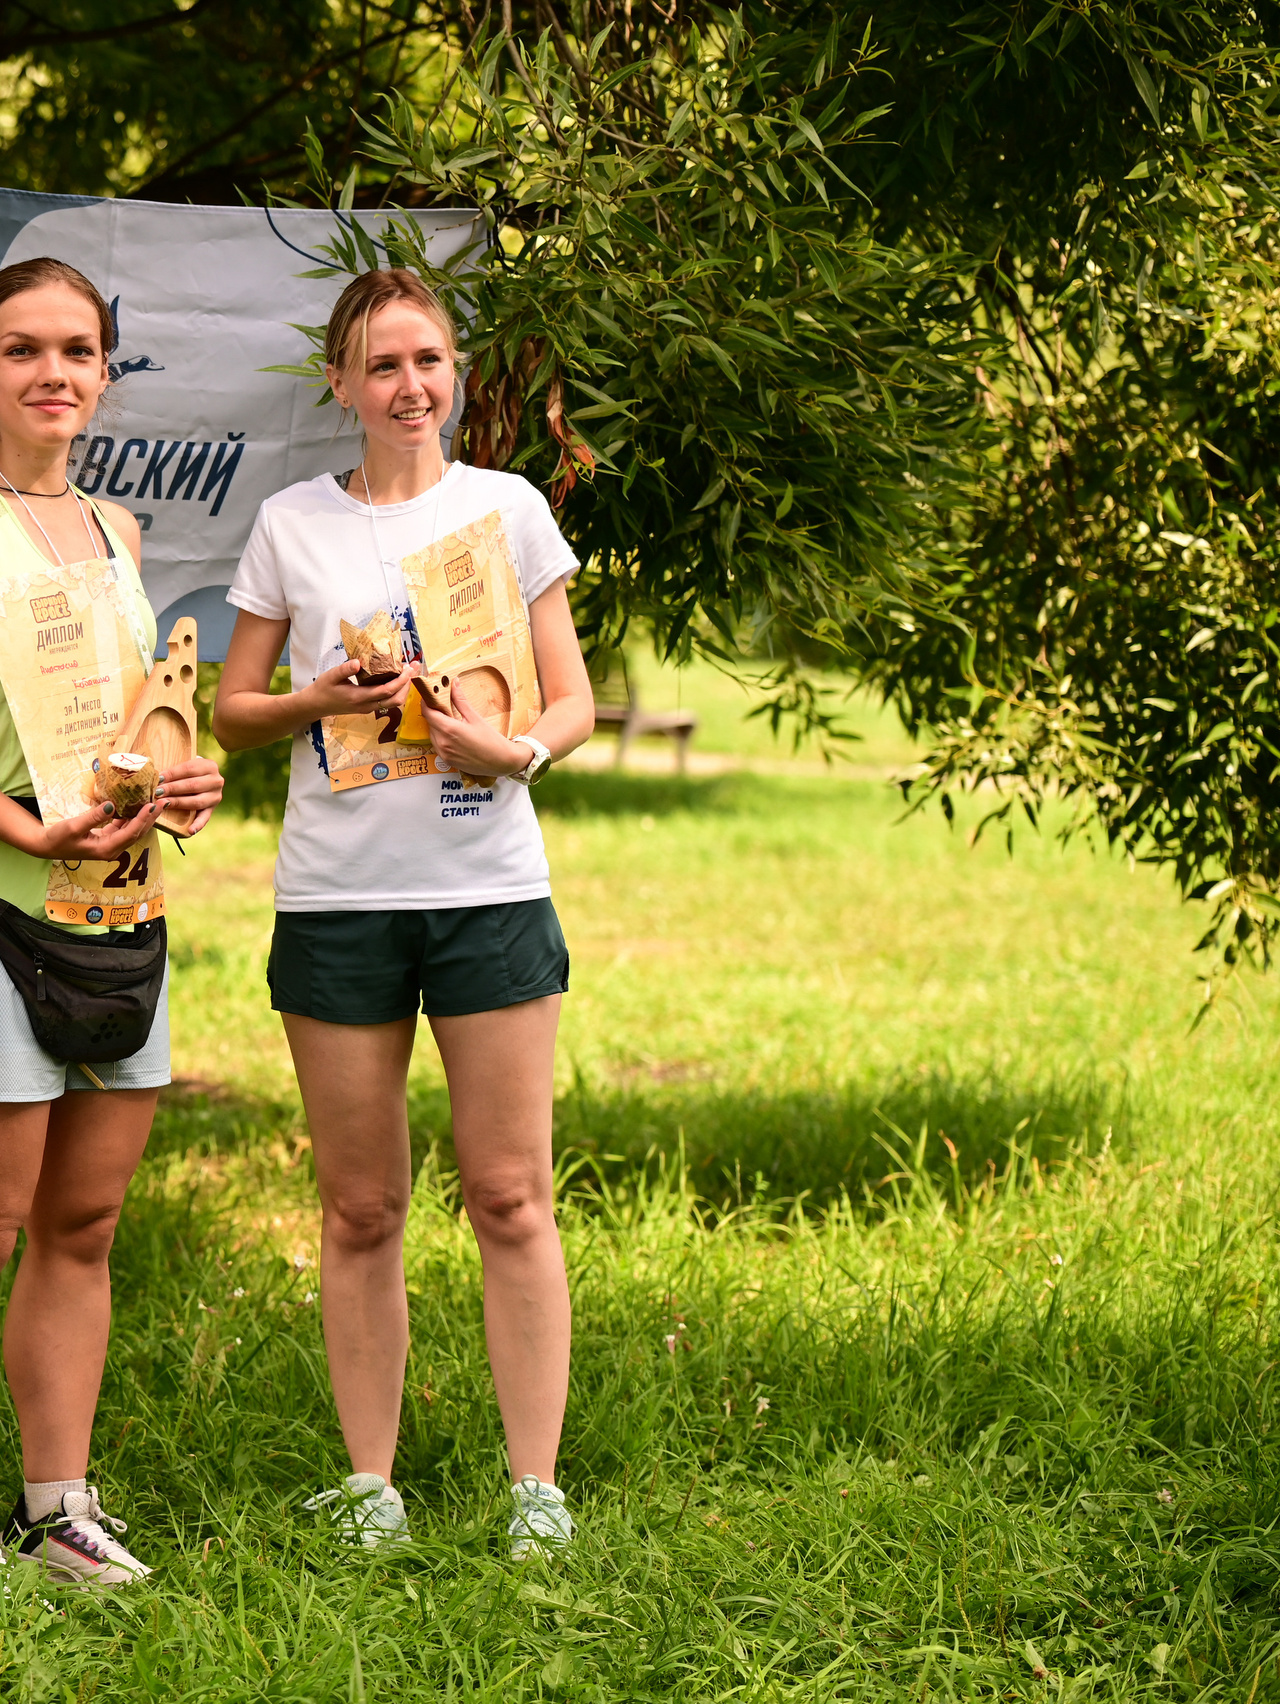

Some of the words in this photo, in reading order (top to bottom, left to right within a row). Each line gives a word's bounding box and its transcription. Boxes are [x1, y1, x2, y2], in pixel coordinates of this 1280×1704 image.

[449, 579, 485, 616] ДИПЛОМ
[37, 622, 84, 652] ДИПЛОМ
[64, 706, 73, 716] ЗА
[73, 696, 79, 714] 1
[81, 699, 101, 713] МЕСТО
[56, 727, 63, 736] НА
[64, 716, 101, 736] ДИСТАНЦИИ
[102, 711, 108, 725] 5
[110, 712, 119, 723] КМ
[440, 790, 493, 804] ГЛАВНЫЙ
[441, 807, 479, 818] СТАРТ!
[102, 847, 150, 888] 24
